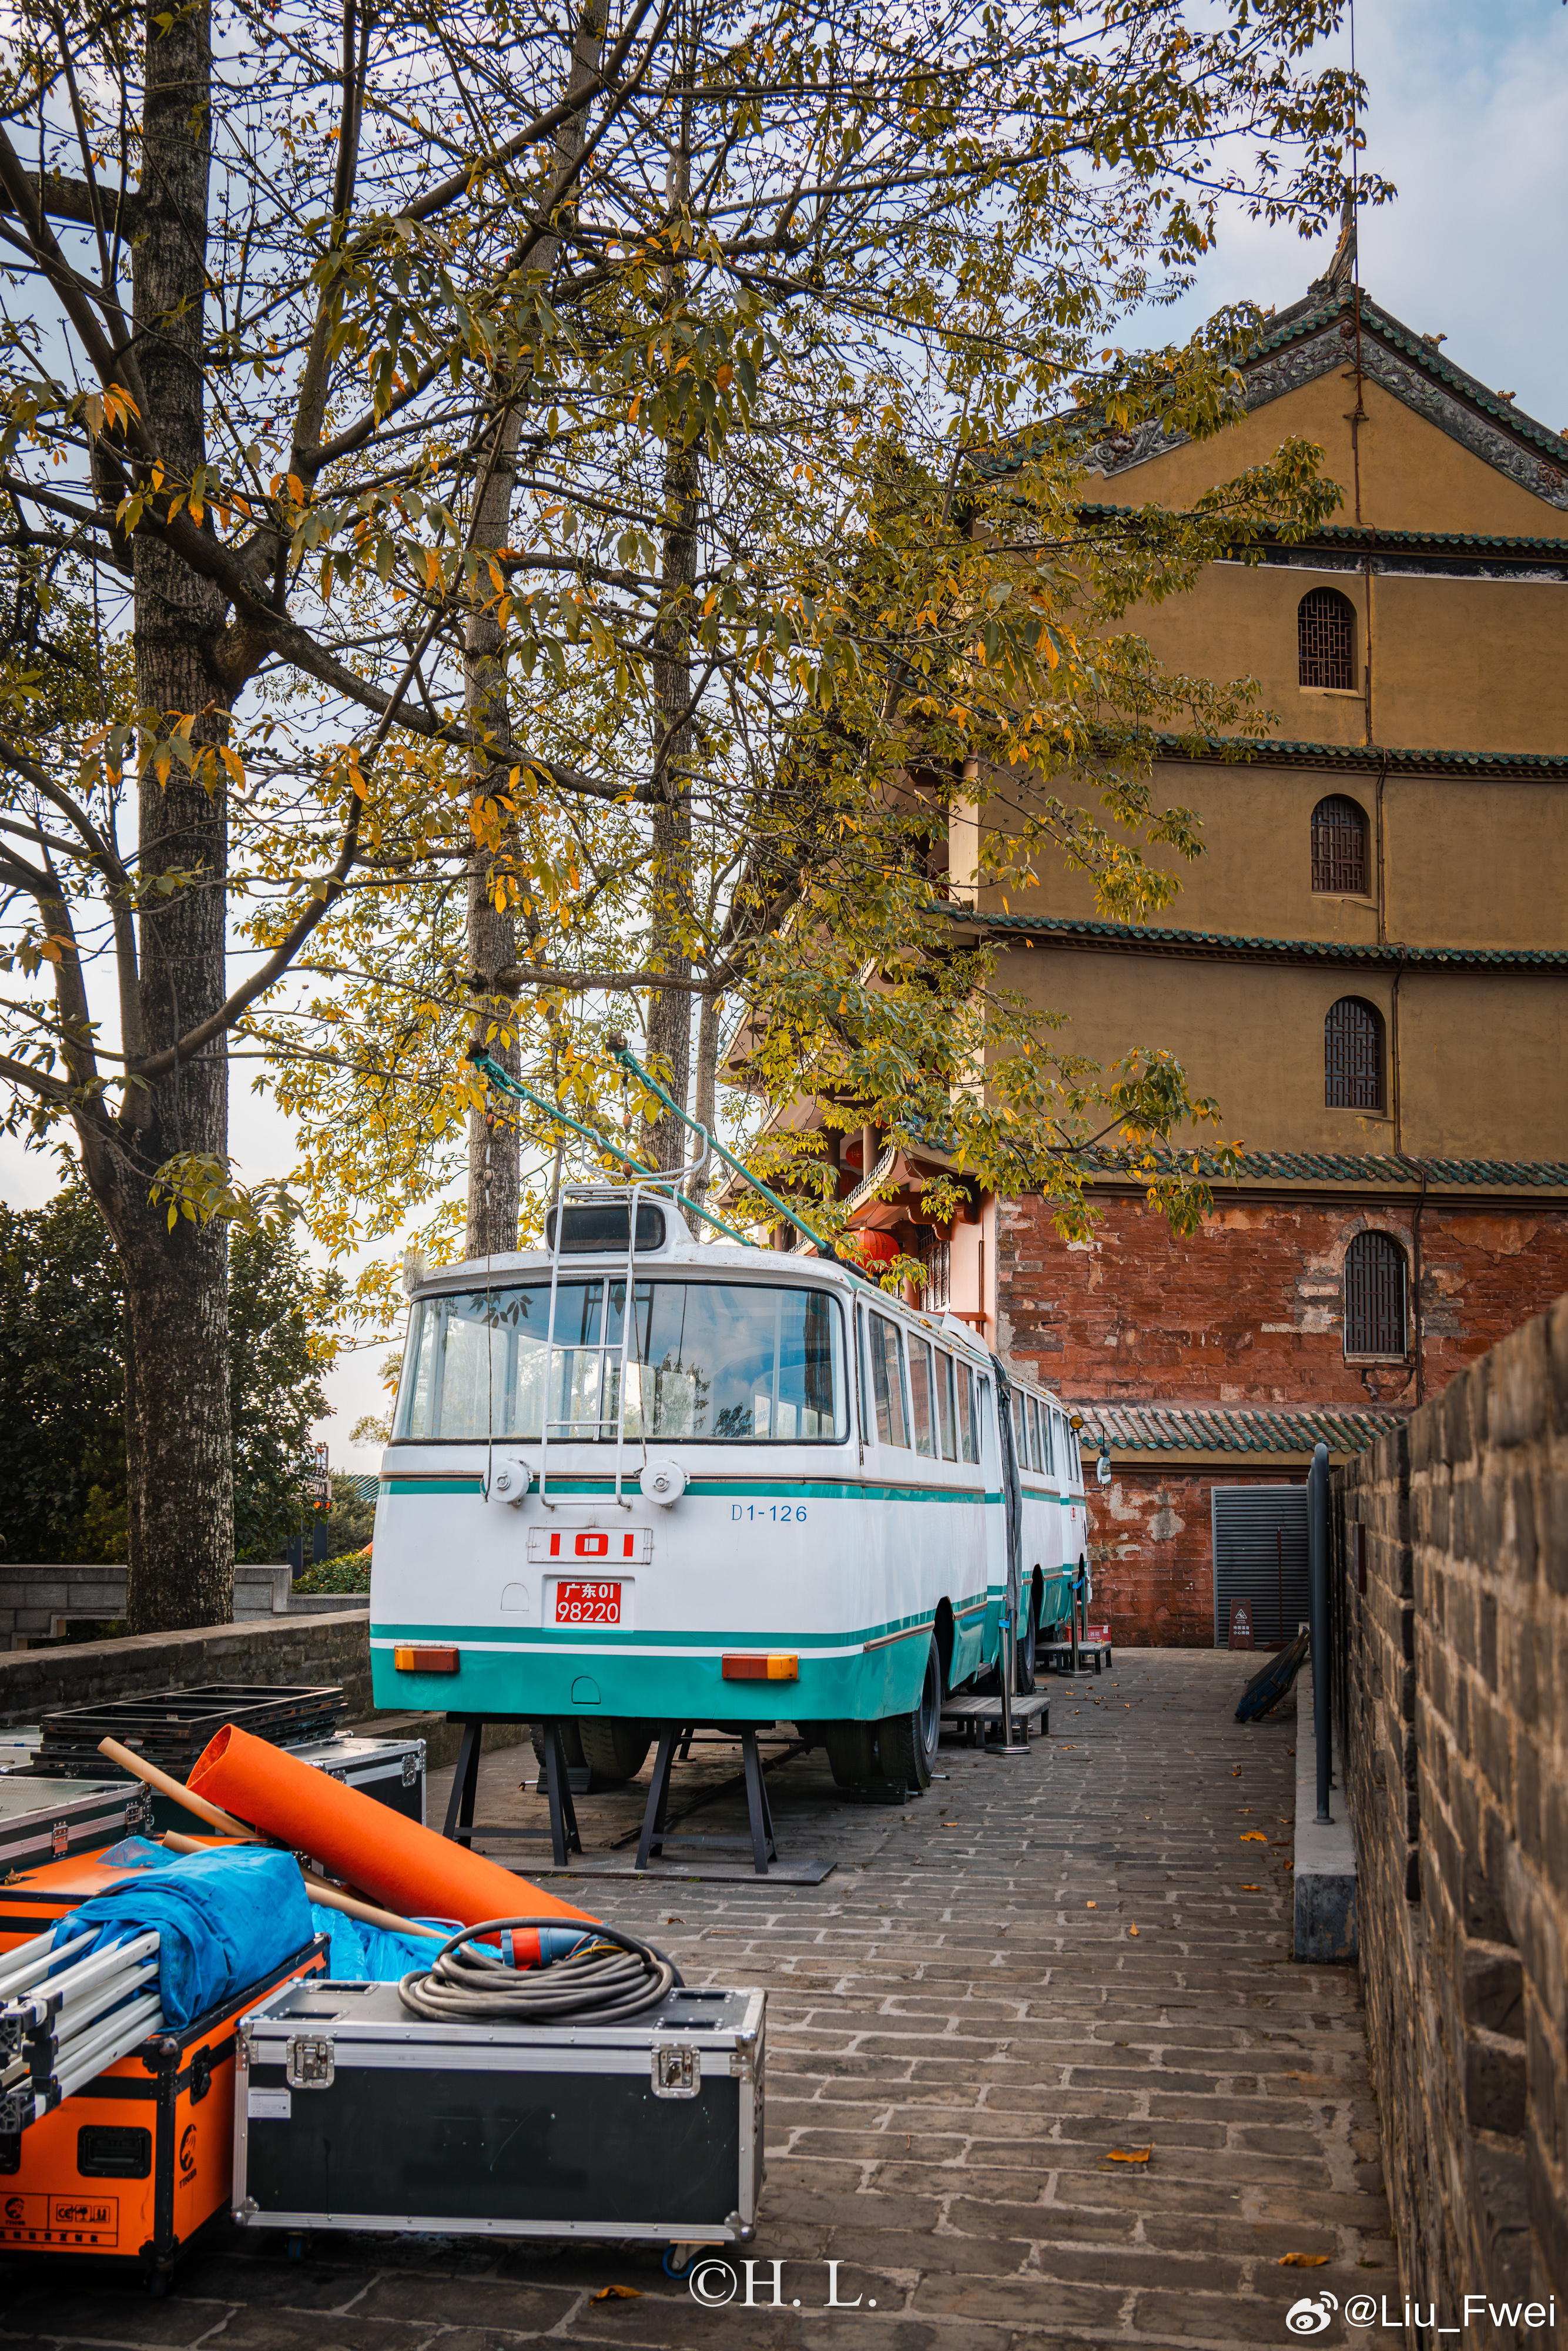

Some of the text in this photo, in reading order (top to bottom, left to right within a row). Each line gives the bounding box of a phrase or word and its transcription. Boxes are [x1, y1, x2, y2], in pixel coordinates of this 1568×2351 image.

[731, 1504, 807, 1522] D1-126
[550, 1533, 634, 1557] 101
[564, 1583, 614, 1599] 广东01
[557, 1601, 618, 1622] 98220
